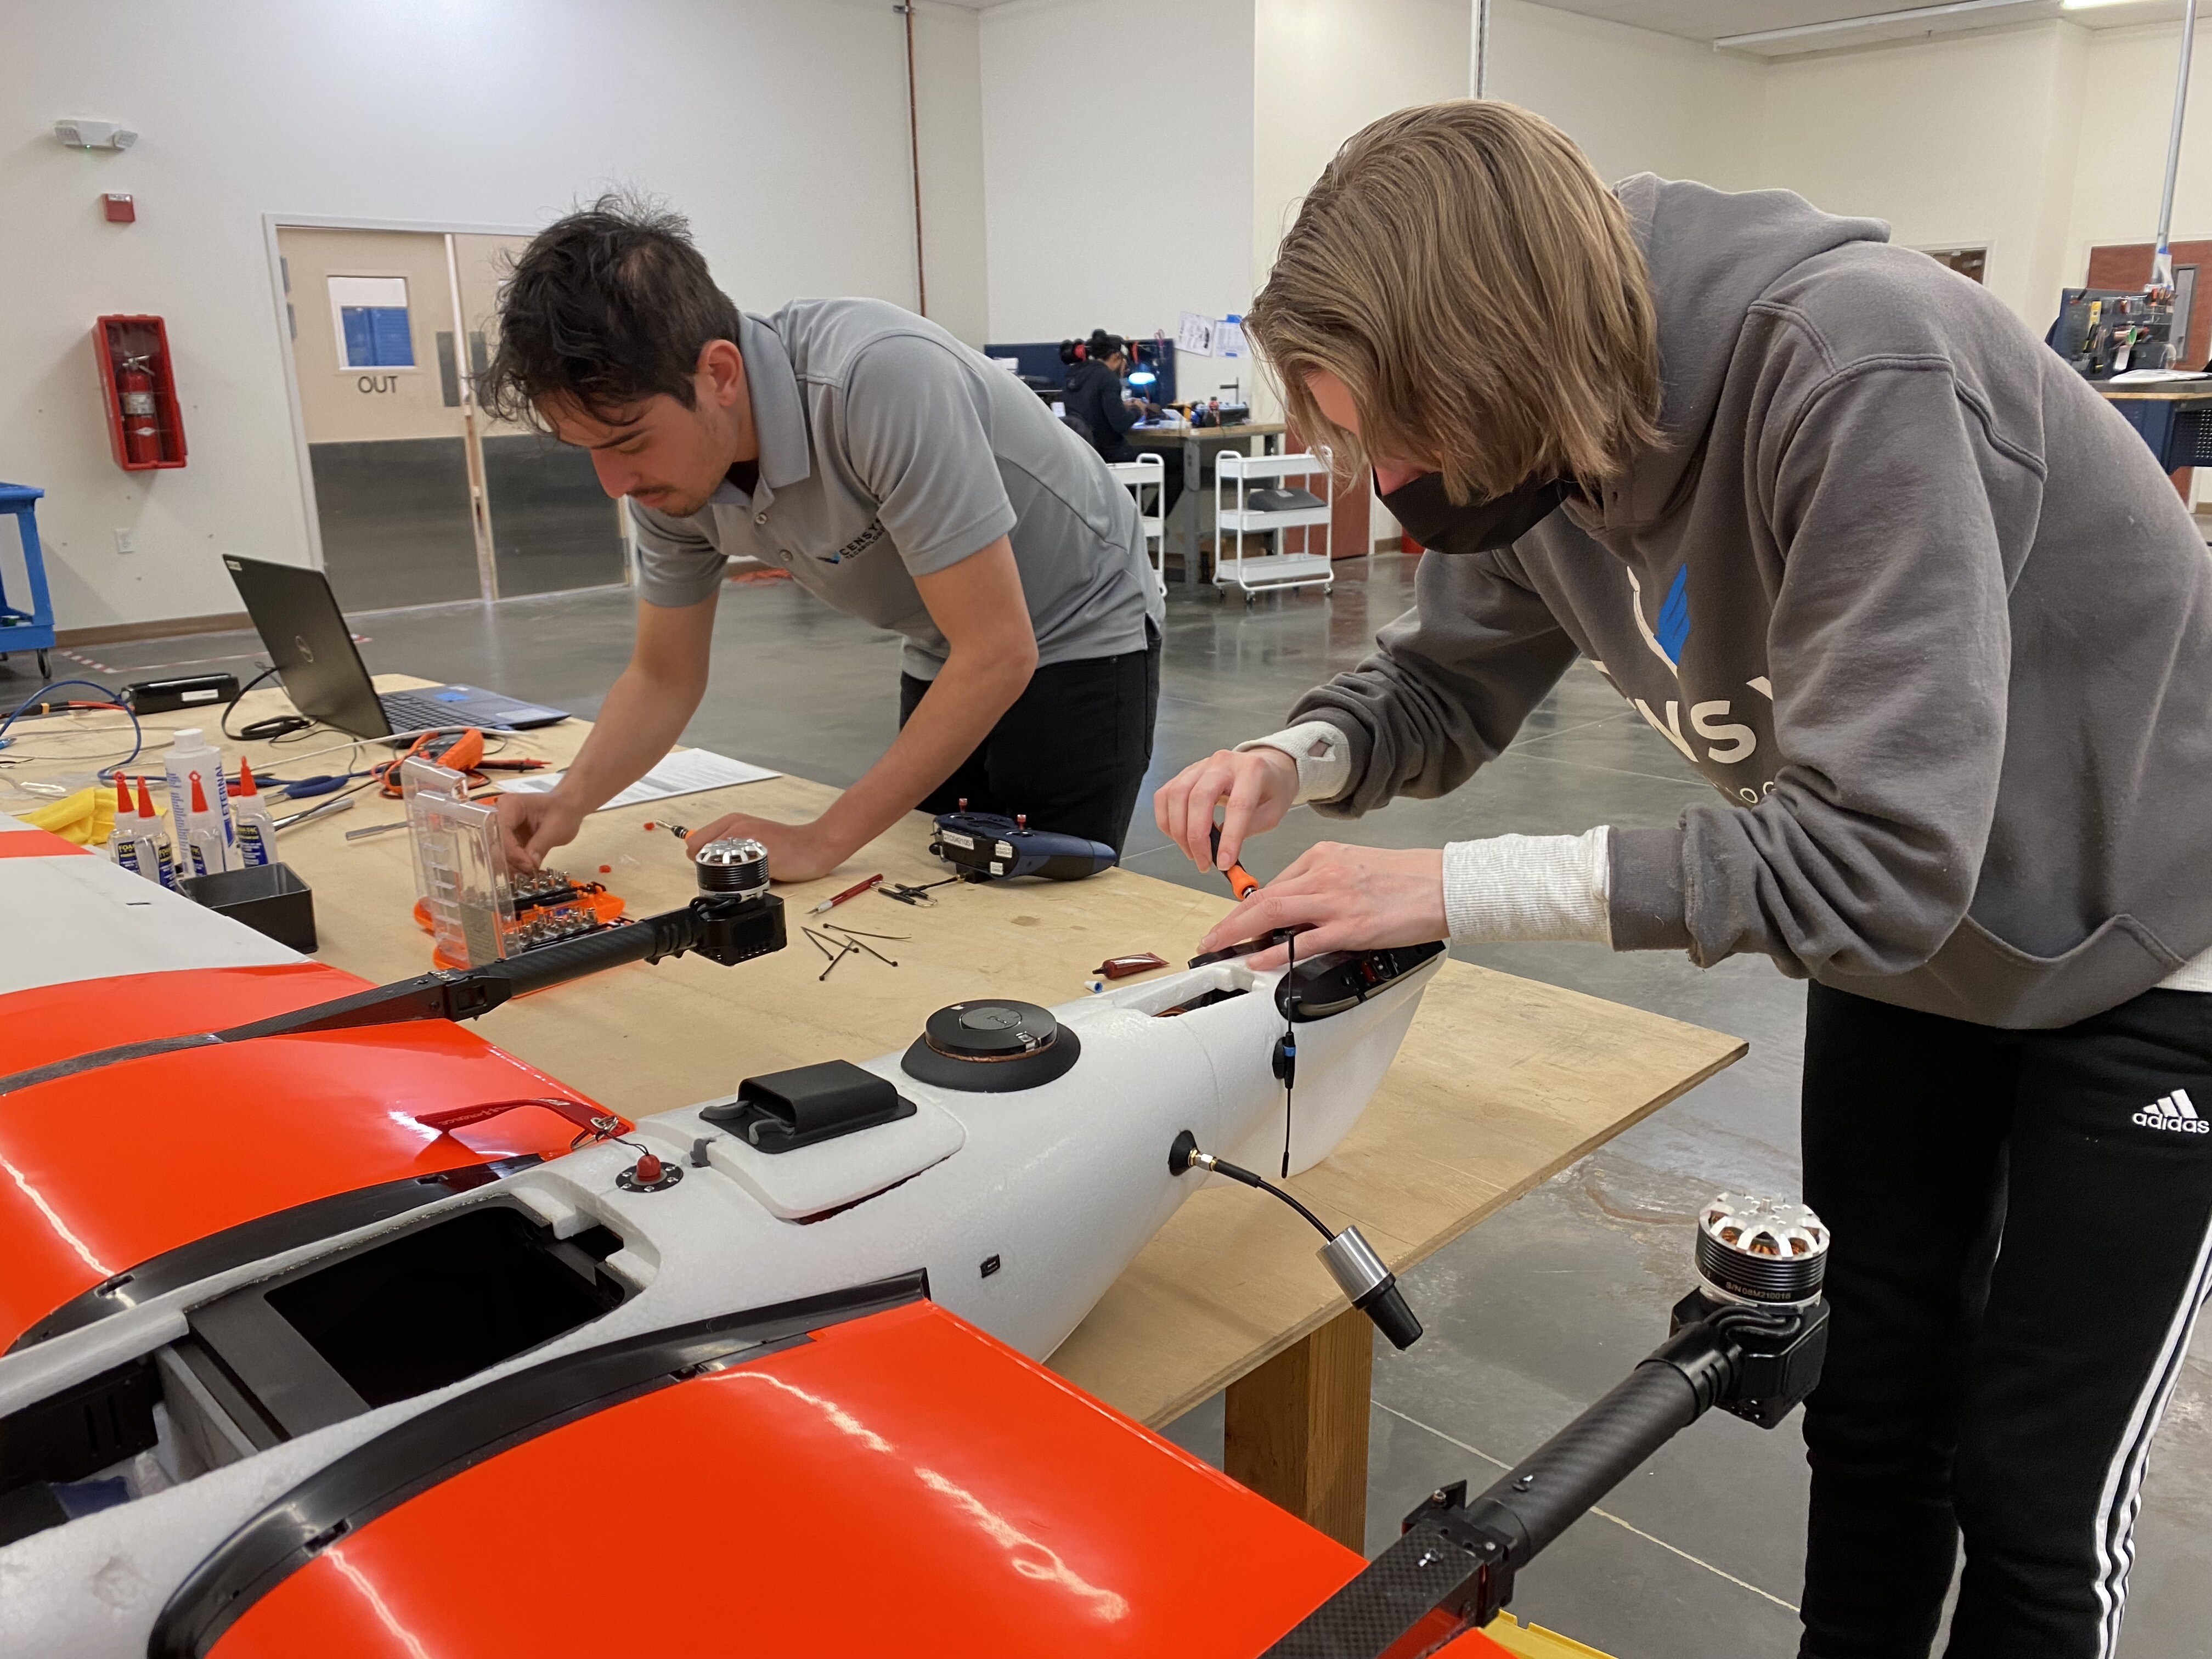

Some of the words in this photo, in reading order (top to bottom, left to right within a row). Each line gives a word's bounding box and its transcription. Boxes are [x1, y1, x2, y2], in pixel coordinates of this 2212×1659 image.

[358, 376, 398, 393] OUT
[215, 765, 229, 816] ETERNAL
[119, 844, 135, 853] FOA
[2132, 1113, 2210, 1134] adidas
